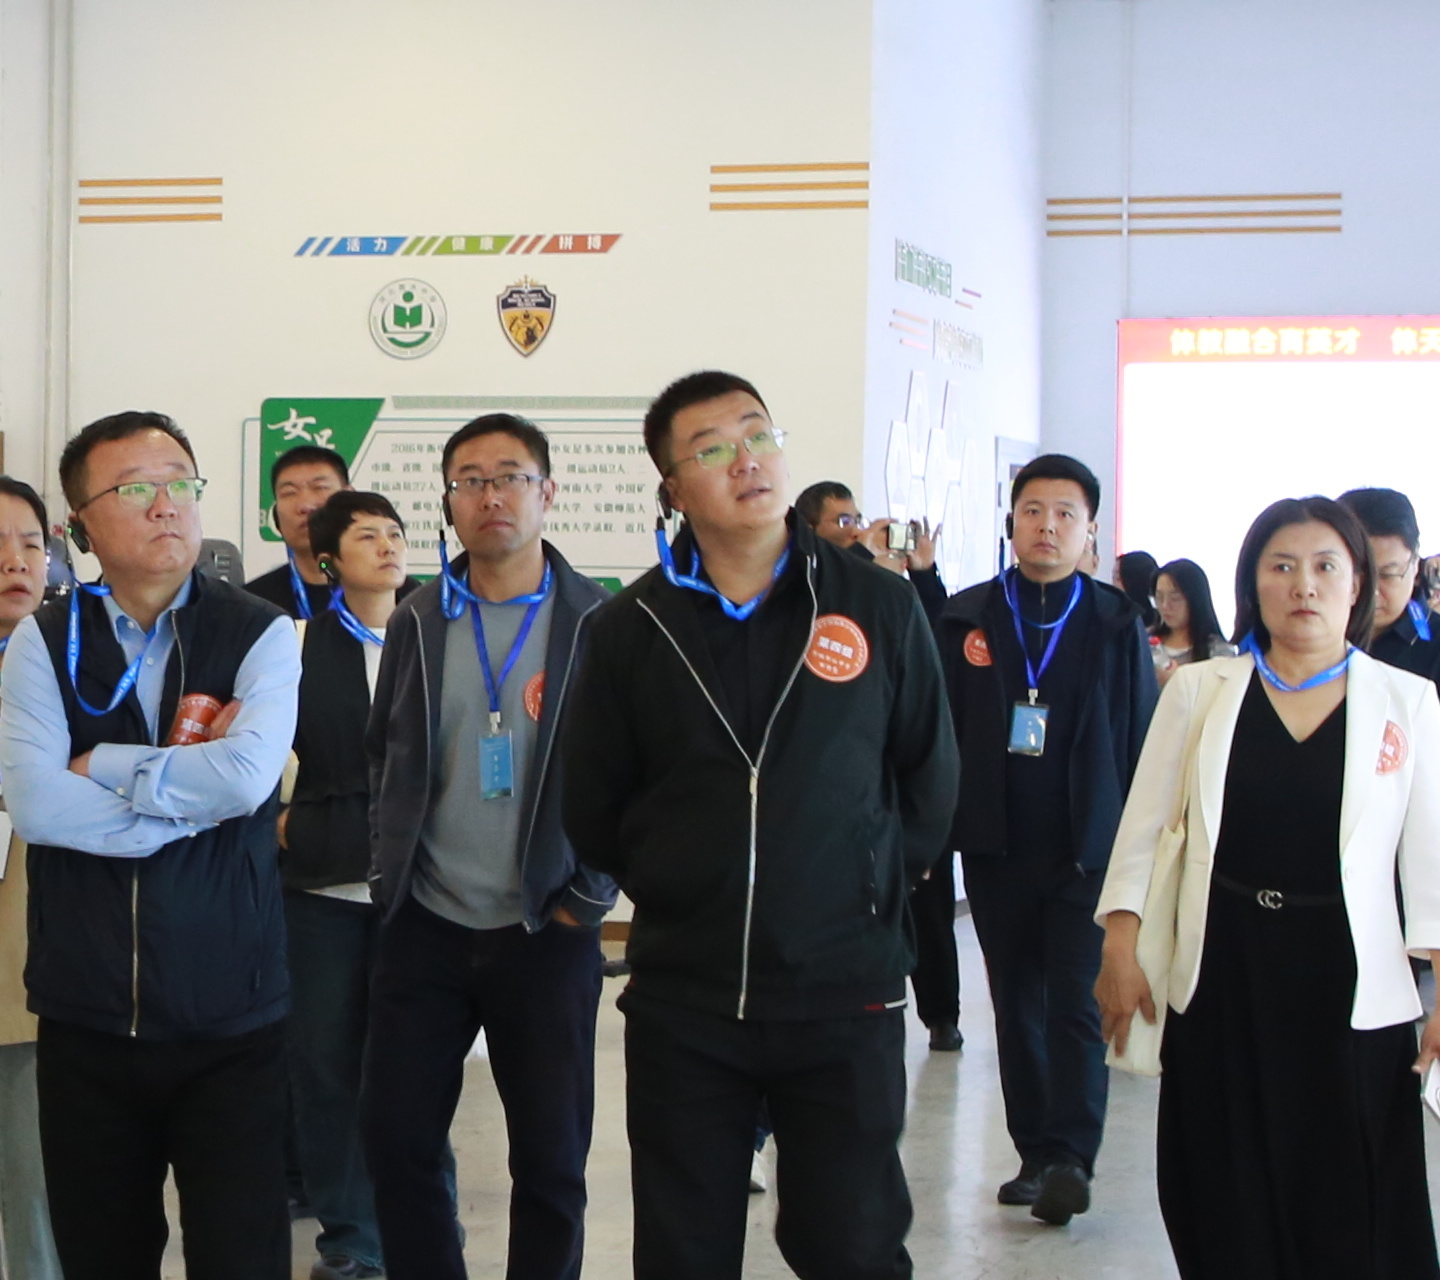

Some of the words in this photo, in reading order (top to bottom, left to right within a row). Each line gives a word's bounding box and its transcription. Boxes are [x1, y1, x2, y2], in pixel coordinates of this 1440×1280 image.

[346, 237, 388, 252] 活力
[451, 236, 494, 252] 健康
[558, 235, 603, 251] 拼搏
